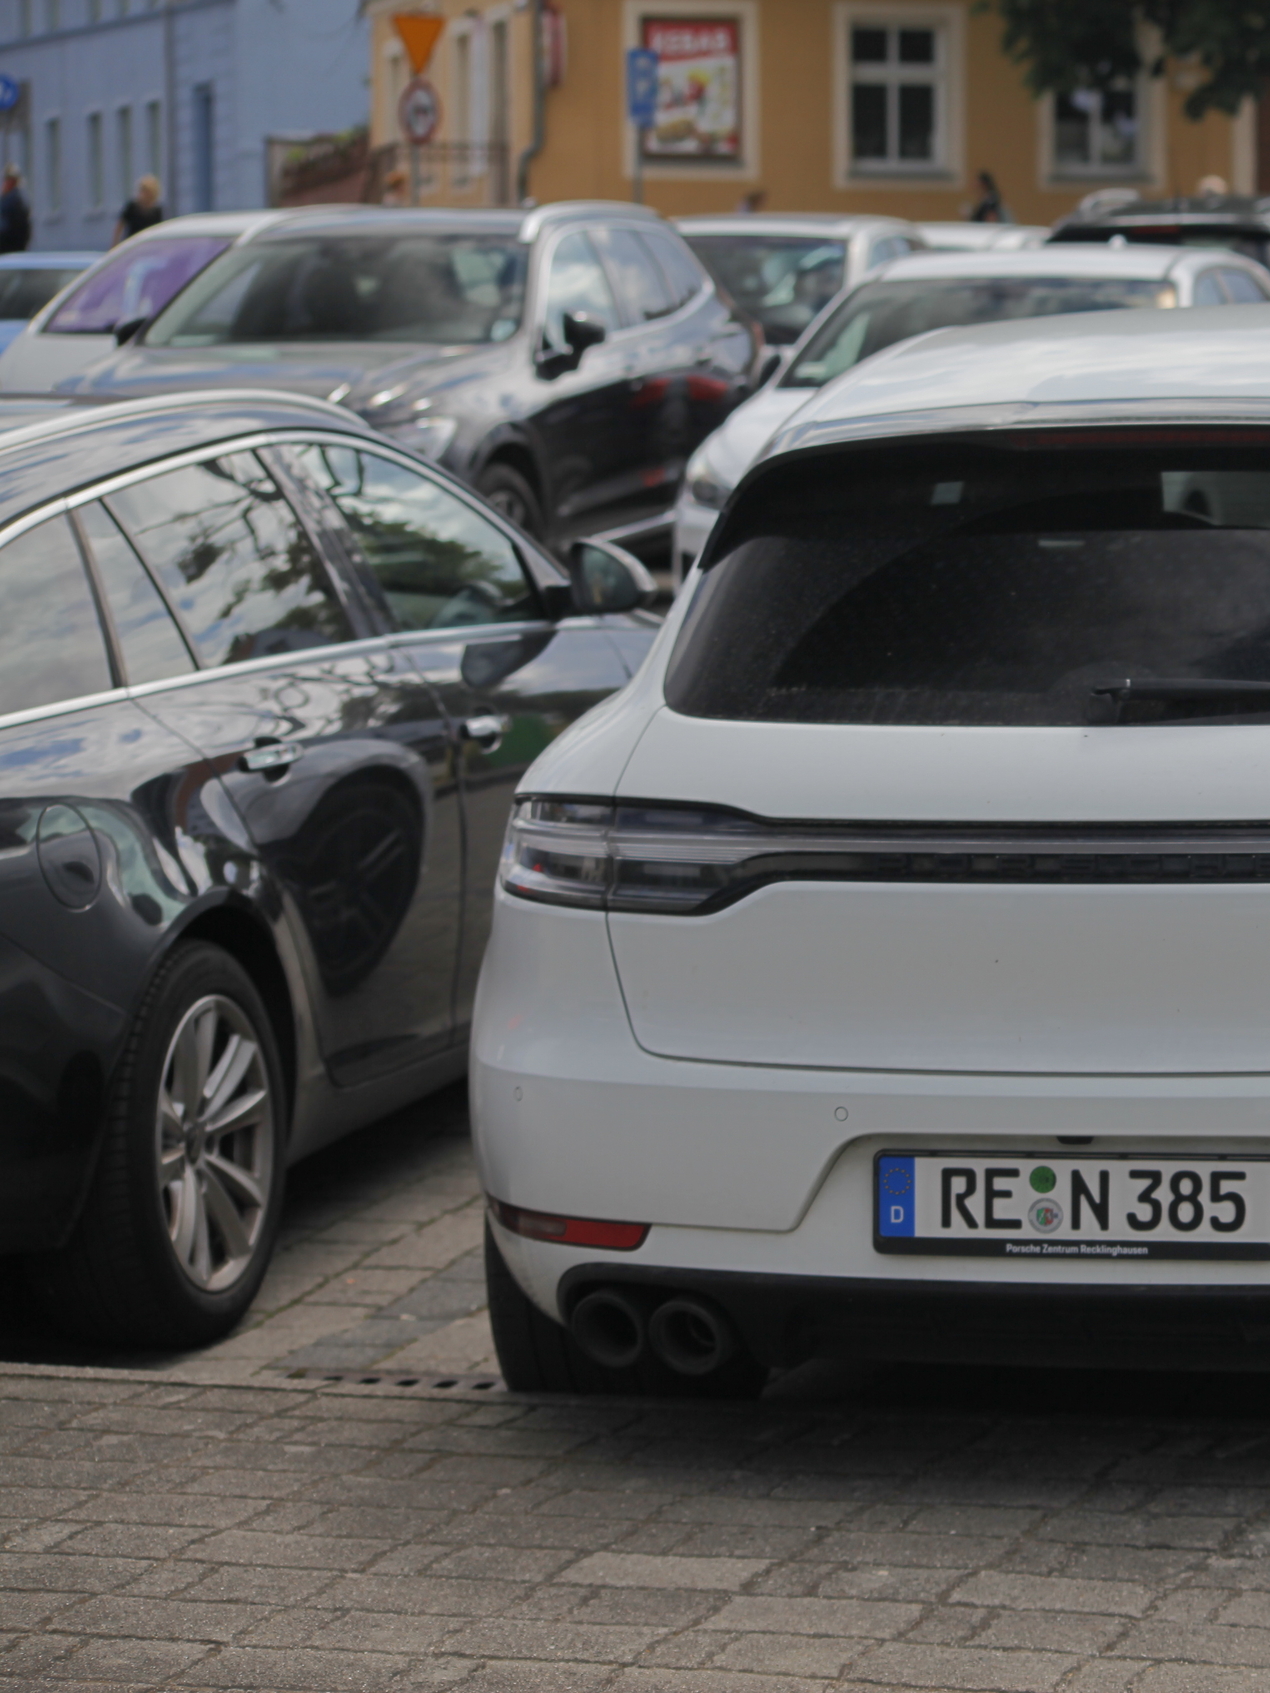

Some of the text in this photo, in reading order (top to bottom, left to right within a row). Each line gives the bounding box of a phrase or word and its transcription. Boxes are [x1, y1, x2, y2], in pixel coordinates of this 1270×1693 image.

[941, 1167, 1246, 1232] RE N 385
[890, 1205, 904, 1223] D
[1006, 1243, 1149, 1257] Porsche Zentrum Recklinghausen
